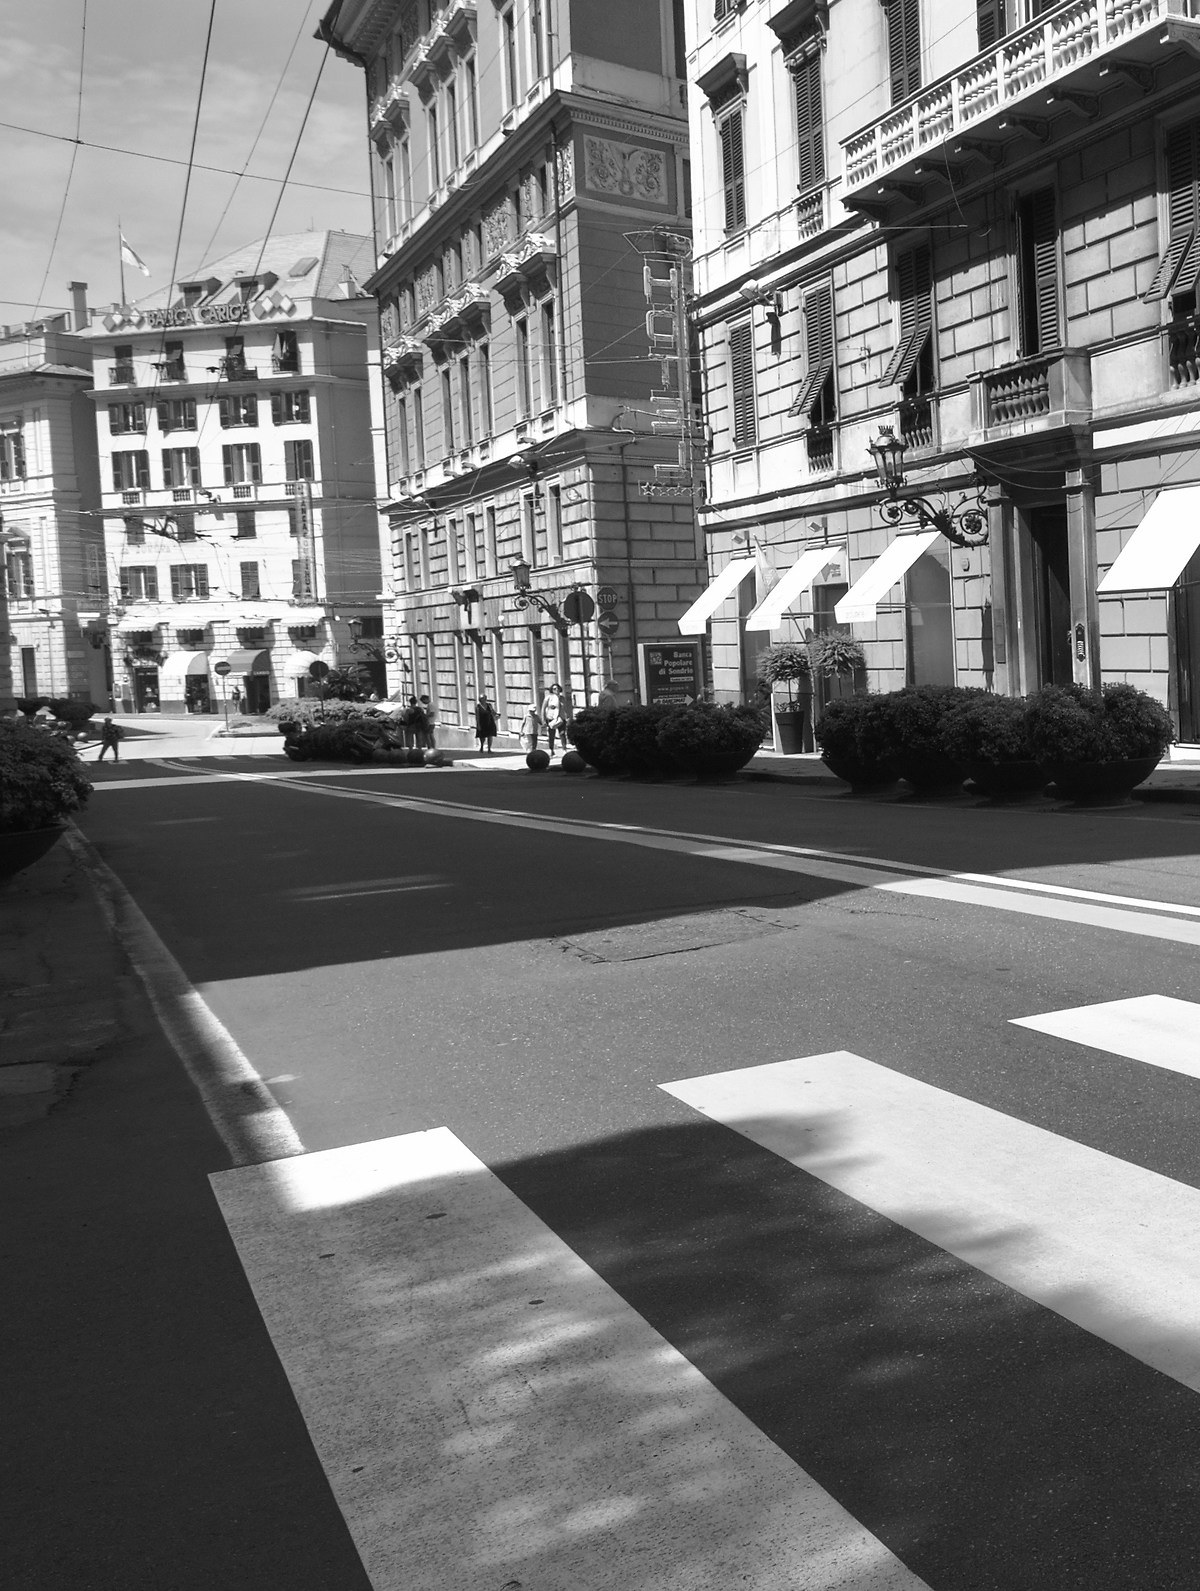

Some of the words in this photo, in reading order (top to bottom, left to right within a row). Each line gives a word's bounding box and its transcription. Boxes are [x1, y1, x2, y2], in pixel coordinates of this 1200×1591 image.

[147, 308, 195, 328] BANCA
[598, 594, 617, 604] STOP
[663, 659, 693, 667] Popolare
[668, 667, 694, 675] Sondrio
